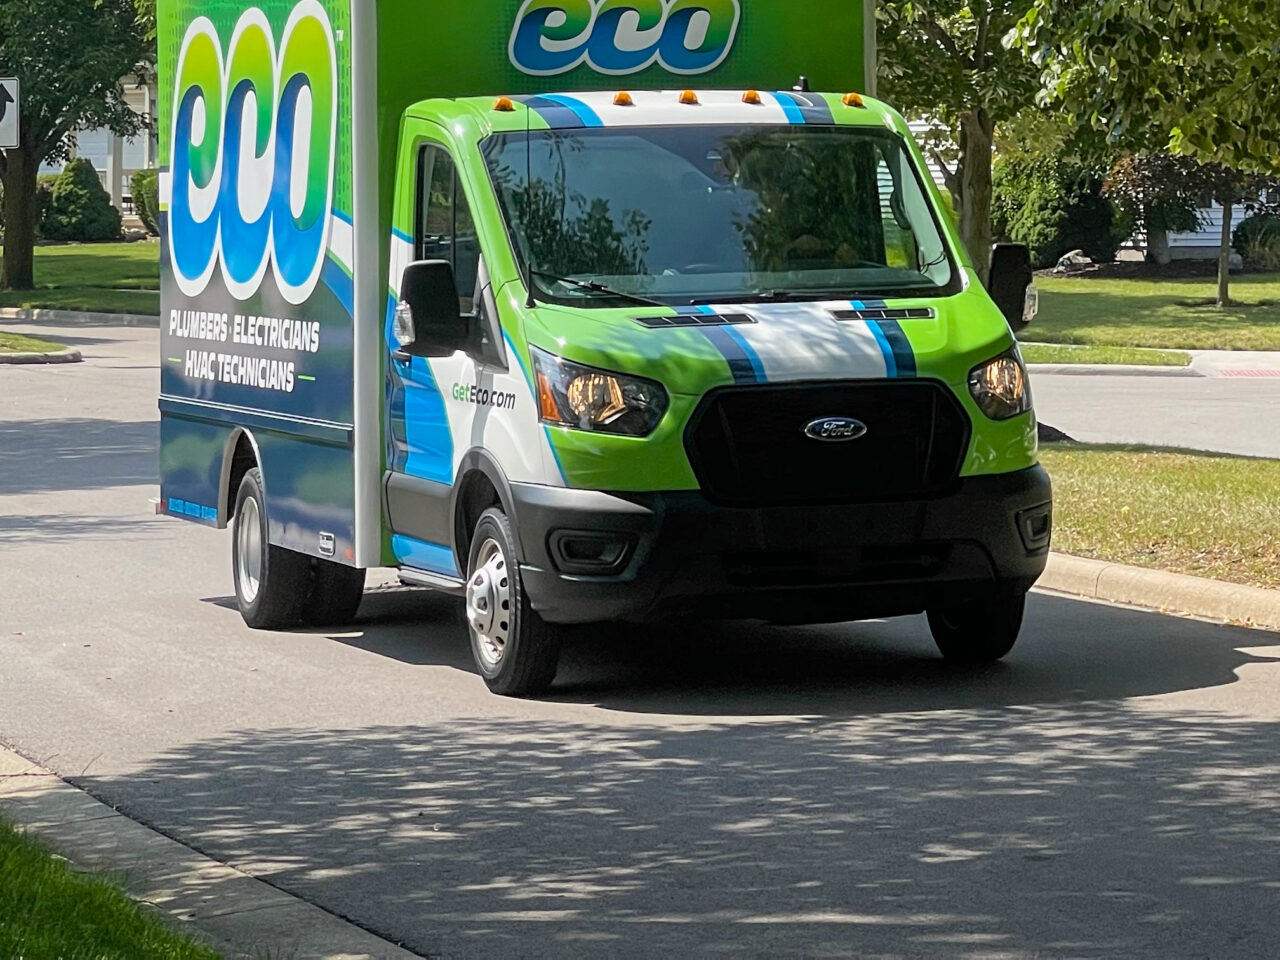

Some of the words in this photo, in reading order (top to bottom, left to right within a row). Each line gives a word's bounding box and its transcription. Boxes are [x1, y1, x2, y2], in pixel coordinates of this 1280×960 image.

[169, 309, 228, 342] PLUMBERS
[233, 314, 320, 353] ELECTRICIANS
[185, 349, 216, 381] HVAC
[218, 353, 295, 393] TECHNICIANS
[452, 382, 516, 410] GetEco.com
[820, 421, 855, 437] Ford
